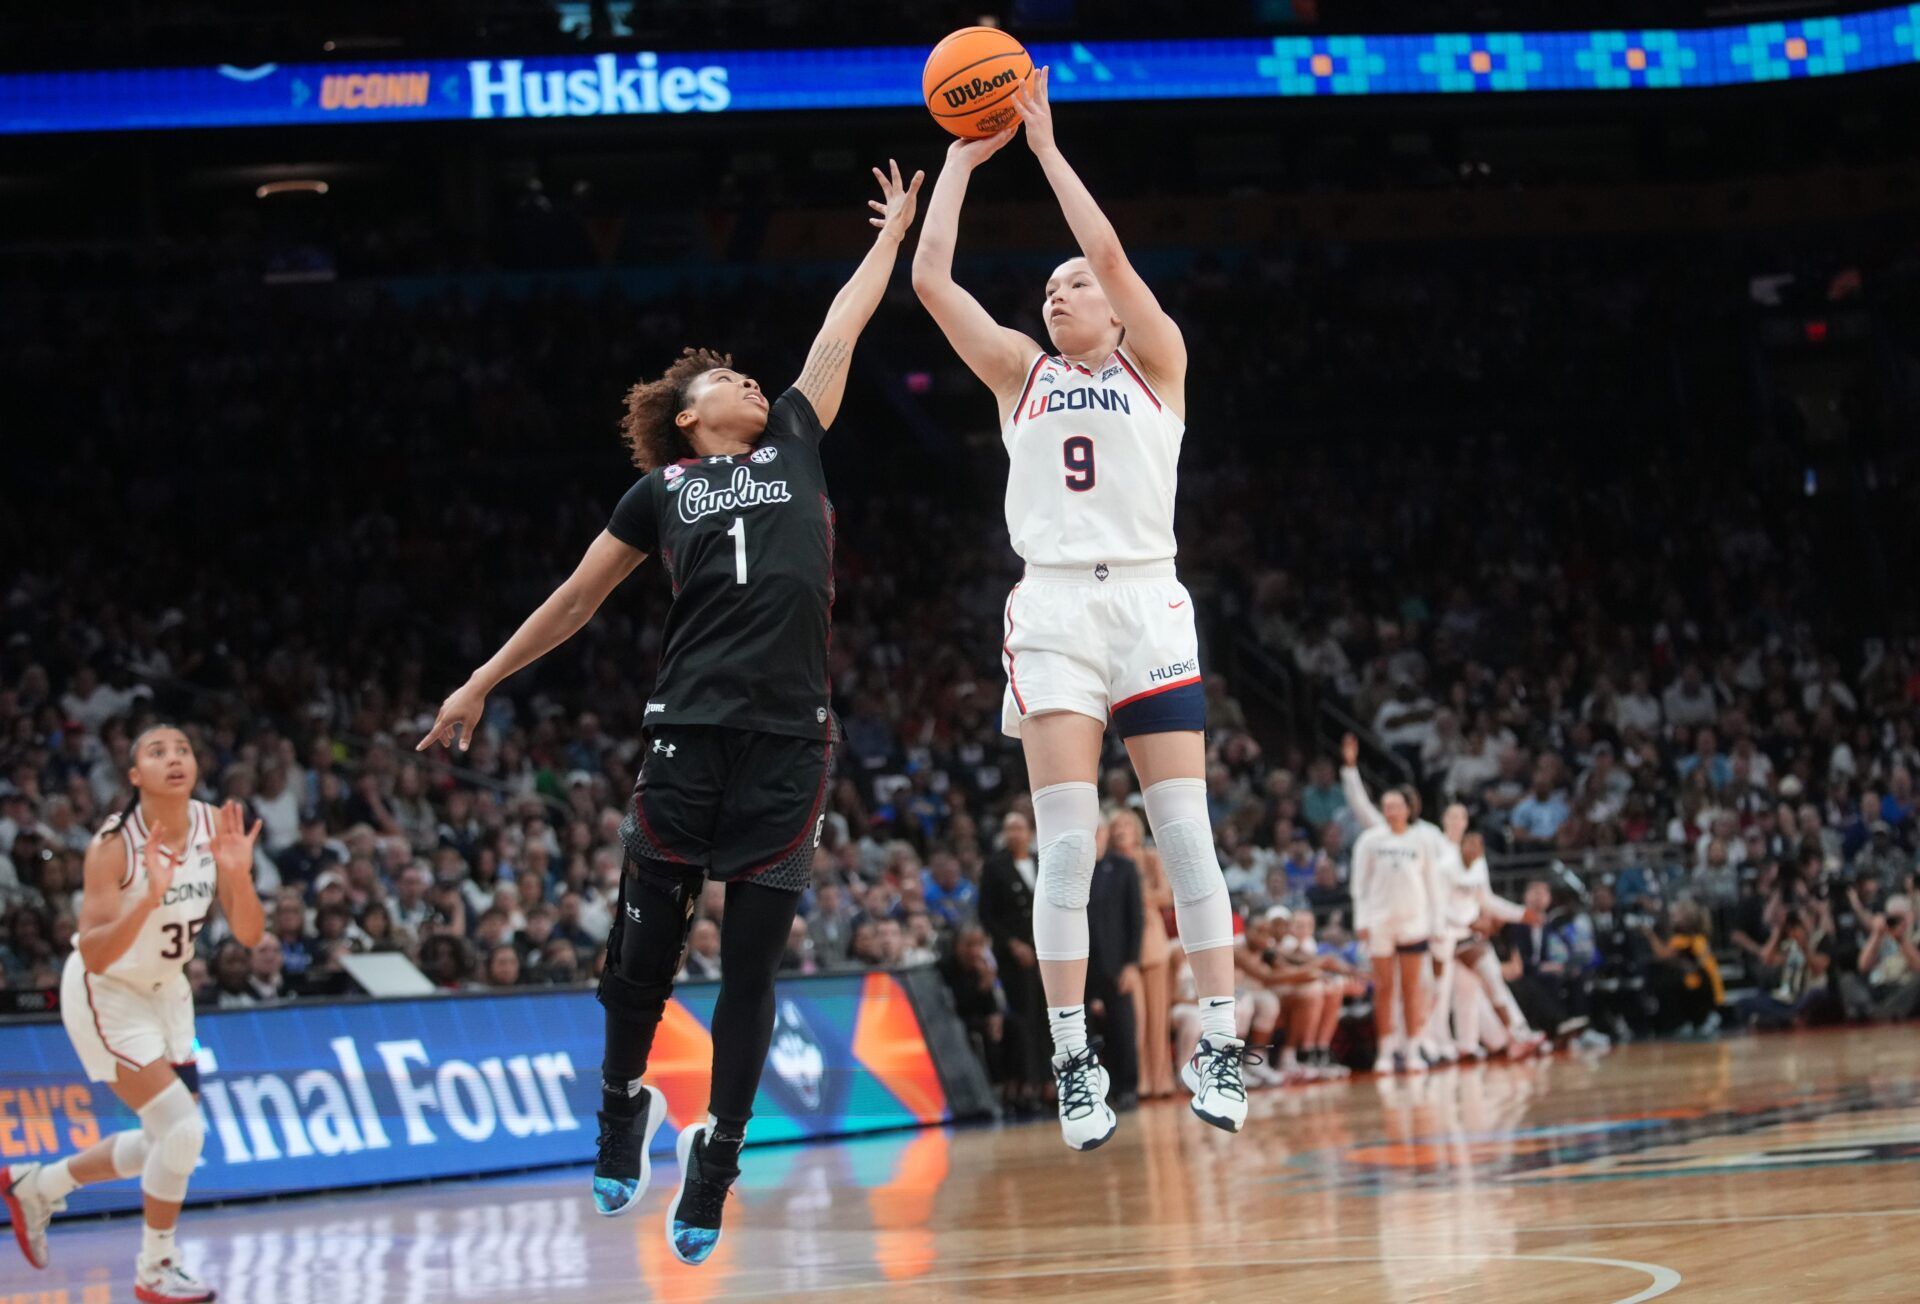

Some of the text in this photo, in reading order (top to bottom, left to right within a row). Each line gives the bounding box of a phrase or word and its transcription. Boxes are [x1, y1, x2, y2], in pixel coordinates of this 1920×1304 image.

[319, 51, 731, 119] UCONN Huskies
[943, 69, 1018, 107] Wilson
[1028, 387, 1131, 420] UCONN
[751, 447, 777, 463] SEC
[1063, 435, 1096, 492] 9
[678, 466, 792, 524] Carolina
[727, 517, 748, 585] 1
[163, 882, 215, 906] CONN
[195, 1036, 391, 1167] inal
[375, 1038, 580, 1145] Four
